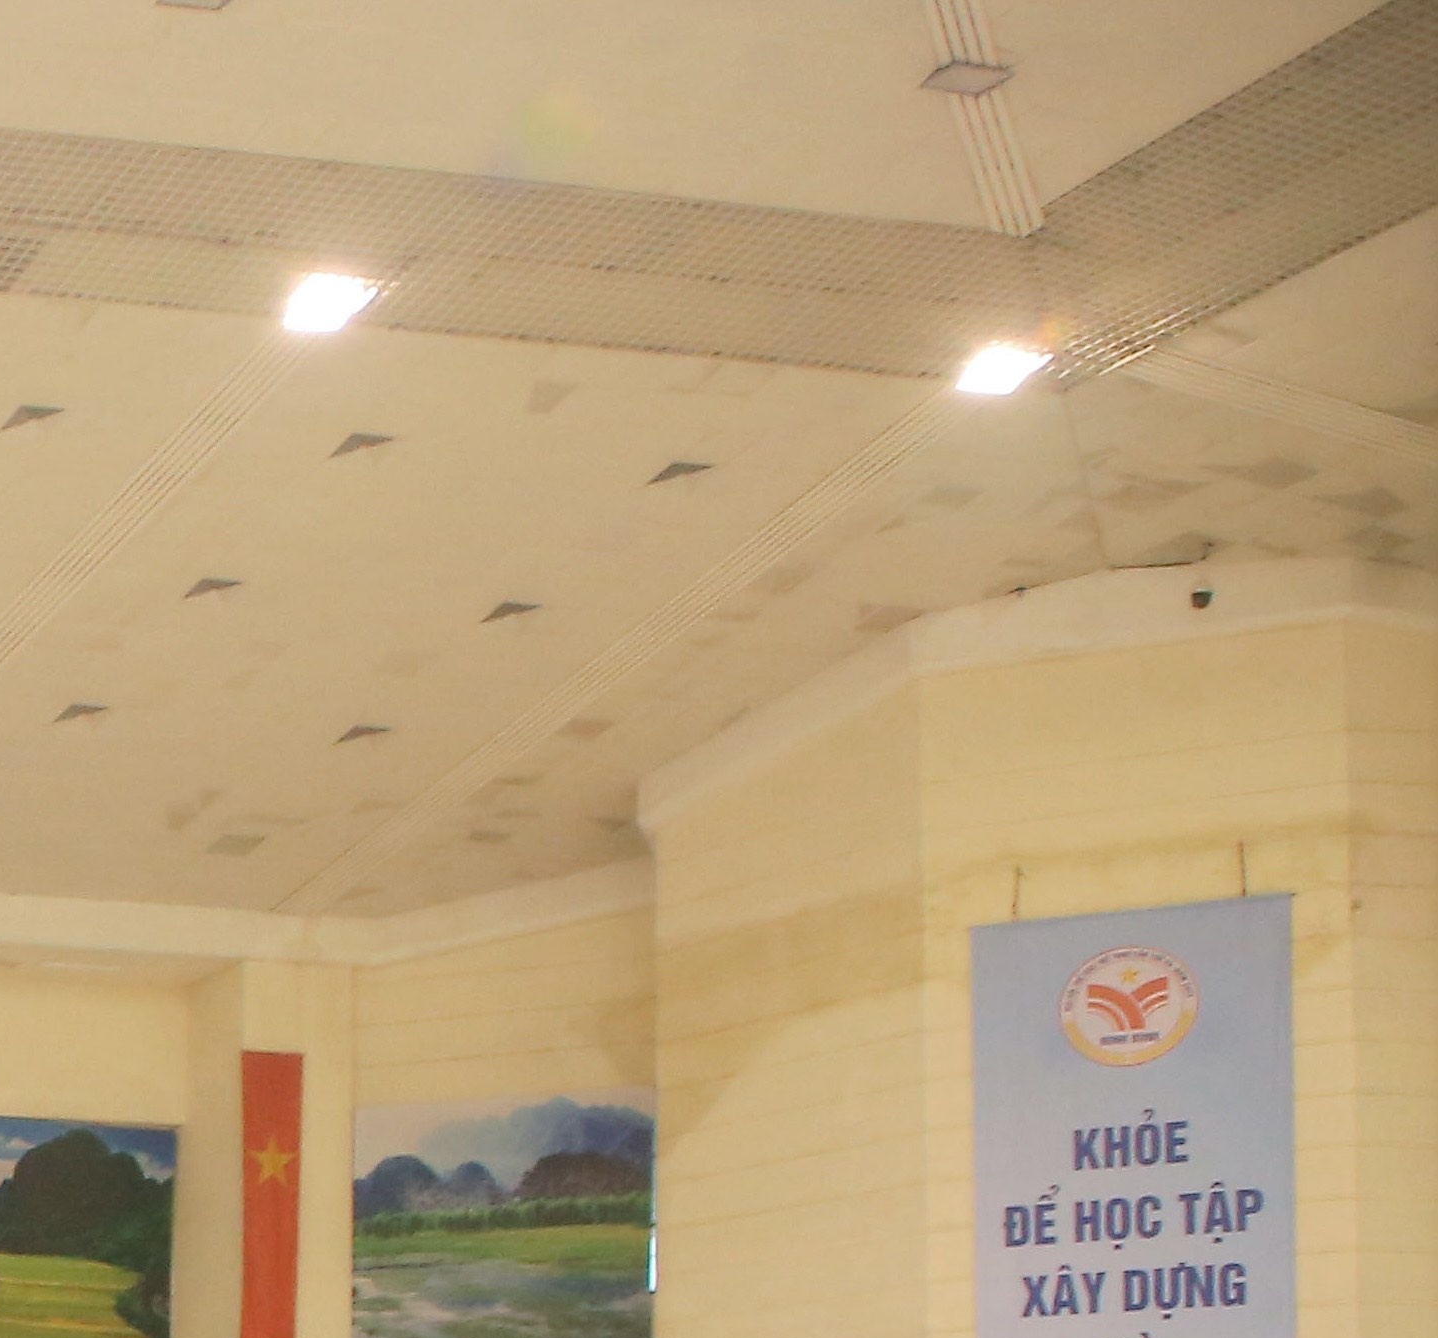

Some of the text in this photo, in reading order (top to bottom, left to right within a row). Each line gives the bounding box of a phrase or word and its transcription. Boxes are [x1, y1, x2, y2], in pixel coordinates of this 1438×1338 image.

[1073, 1108, 1188, 1172] KHỎE
[1004, 1180, 1264, 1251] ĐỂ HỌC TẬP
[1022, 1262, 1246, 1320] XÂY DỰNG
